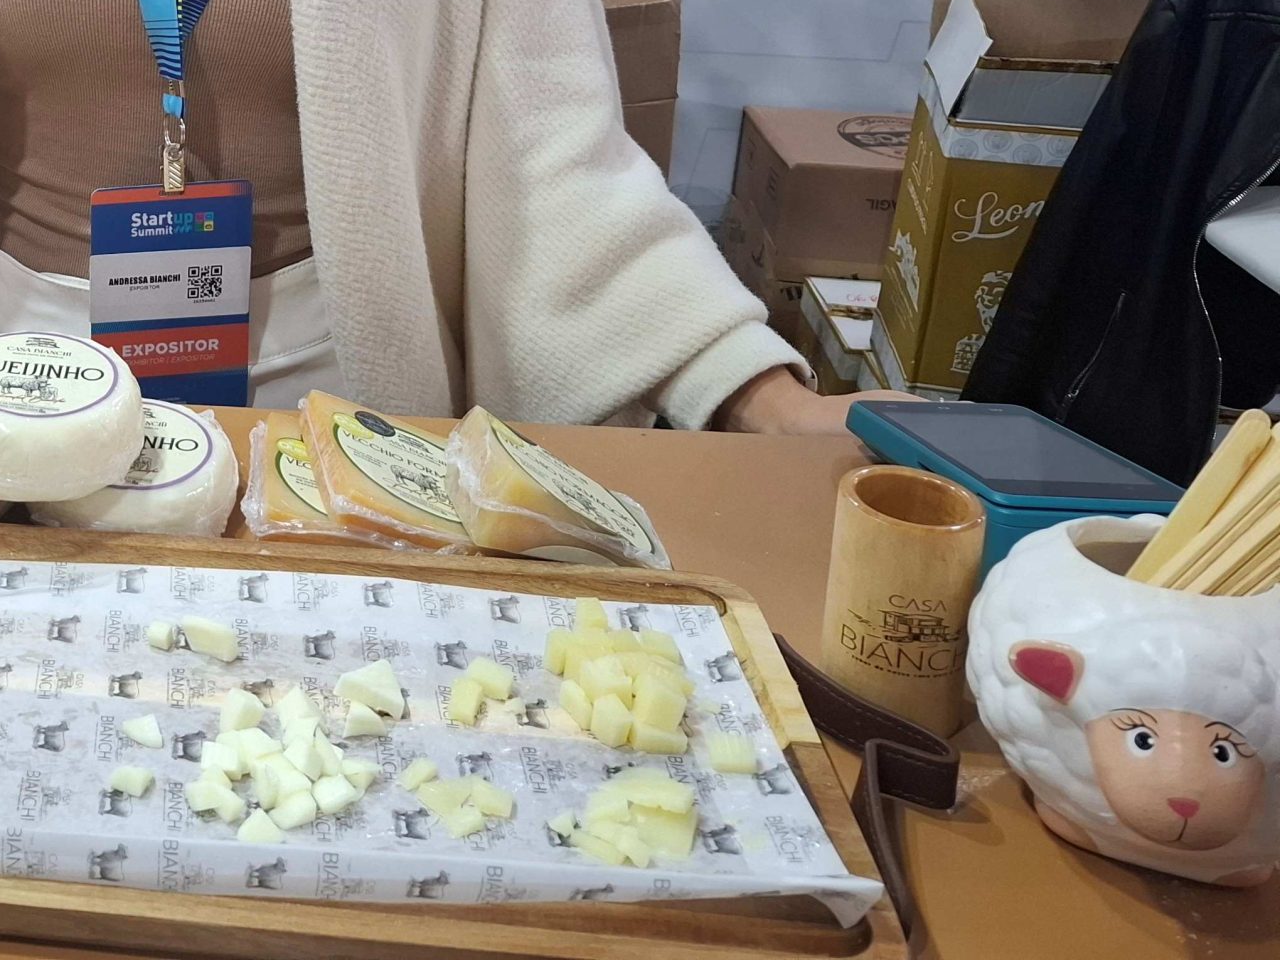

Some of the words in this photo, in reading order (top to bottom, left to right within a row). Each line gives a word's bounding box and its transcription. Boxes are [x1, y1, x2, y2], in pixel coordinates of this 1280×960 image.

[131, 211, 194, 227] Startup
[131, 226, 173, 237] Summit
[951, 191, 1045, 243] Leon
[109, 276, 148, 286] ANDRESSA
[150, 274, 181, 283] BIANCHI
[122, 338, 219, 357] EXPOSITOR
[129, 358, 164, 366] XHIBITOR
[171, 354, 216, 363] EXPOSITOR
[421, 583, 438, 619] ANCHI
[888, 594, 947, 612] CASA
[106, 610, 121, 653] BIANCHI
[679, 606, 697, 638] ANCHI
[363, 626, 379, 662] BIANC
[494, 639, 514, 666] BIANC
[840, 623, 965, 671] BIANC
[37, 659, 56, 700] BIANCHI
[170, 668, 185, 710] BIANCHI
[97, 715, 115, 762] BIANCHI
[720, 704, 740, 737] BIANC
[522, 746, 547, 794] BIANCHI
[668, 755, 689, 784] BIAN
[19, 770, 42, 821] BIANCHI
[166, 782, 184, 832] BIANCHI
[315, 810, 331, 841] NCHI
[766, 816, 803, 863] BIANCHI
[5, 827, 23, 875] BIAN
